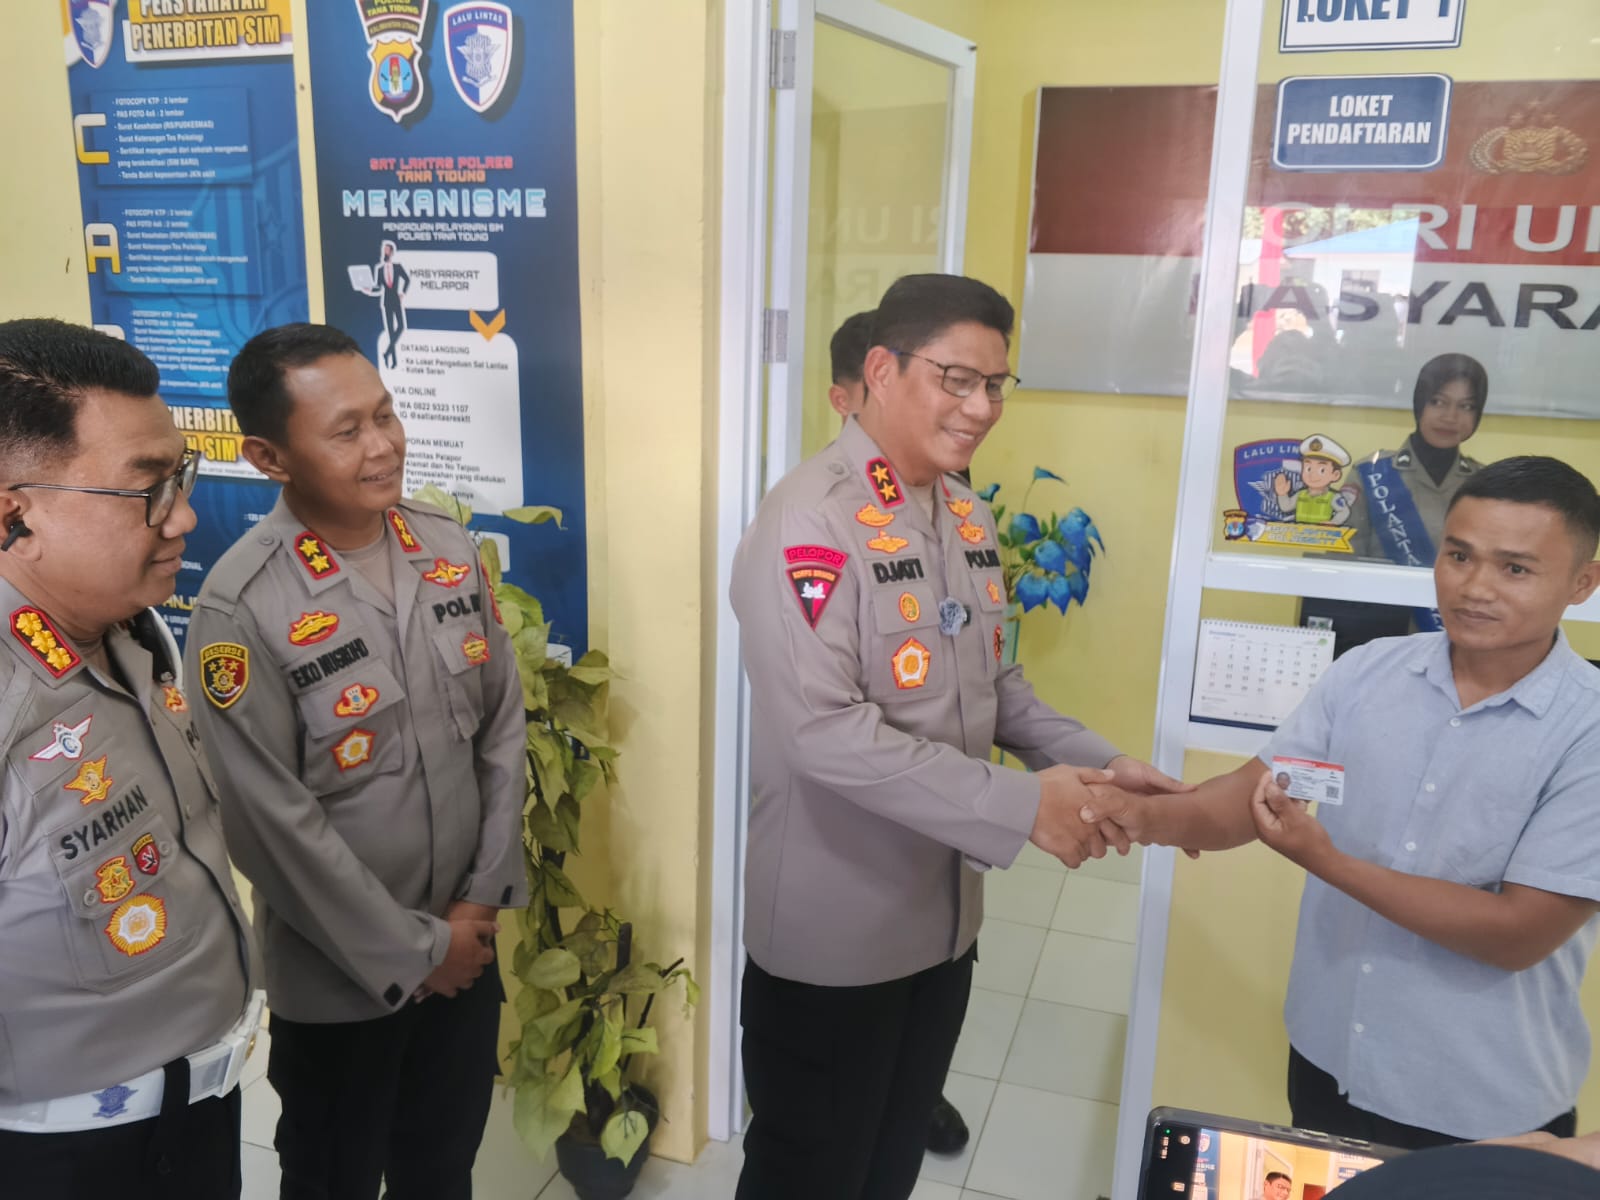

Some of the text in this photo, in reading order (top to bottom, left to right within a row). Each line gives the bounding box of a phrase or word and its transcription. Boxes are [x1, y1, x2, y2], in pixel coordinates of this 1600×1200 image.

[453, 11, 503, 26] LALU LINTAS
[131, 15, 281, 50] PENERBITAN SIM
[1329, 94, 1393, 117] LOKET
[74, 113, 110, 164] C
[1286, 121, 1432, 144] PENDAFTARAN
[370, 156, 513, 170] SAT LANTAS POLRES
[397, 170, 486, 183] TANA TIDUNG
[342, 188, 547, 217] MEKANISME
[382, 222, 503, 232] PENGADUAN PELAYANAN SIM
[397, 232, 489, 242] POLRES TANA TIDUNG
[85, 223, 121, 274] A
[410, 269, 480, 280] MASYARAKAT
[420, 280, 470, 291] MELAPOR
[401, 344, 470, 355] DATANG LANGSUNG
[415, 358, 434, 366] Loket
[435, 359, 472, 368] Pengaduan
[473, 361, 485, 369] Sat
[486, 362, 509, 371] Lantas
[426, 367, 446, 376] Saran
[393, 386, 437, 397] VIA ONLINE
[399, 401, 412, 409] WA
[204, 436, 238, 462] SIM
[433, 439, 464, 448] MEMUAT
[435, 453, 462, 462] Pelapor
[1243, 445, 1302, 460] LALU LIN
[405, 460, 429, 468] Alamat
[430, 461, 443, 469] dan
[405, 468, 506, 483] Permasalahan yang diadukan
[1367, 472, 1423, 567] POLANTA
[788, 547, 842, 566] PELOPOR
[872, 558, 924, 583] DJATI
[204, 646, 243, 657] RESERSE
[291, 661, 322, 689] EKO
[60, 785, 148, 860] SYARHAN
